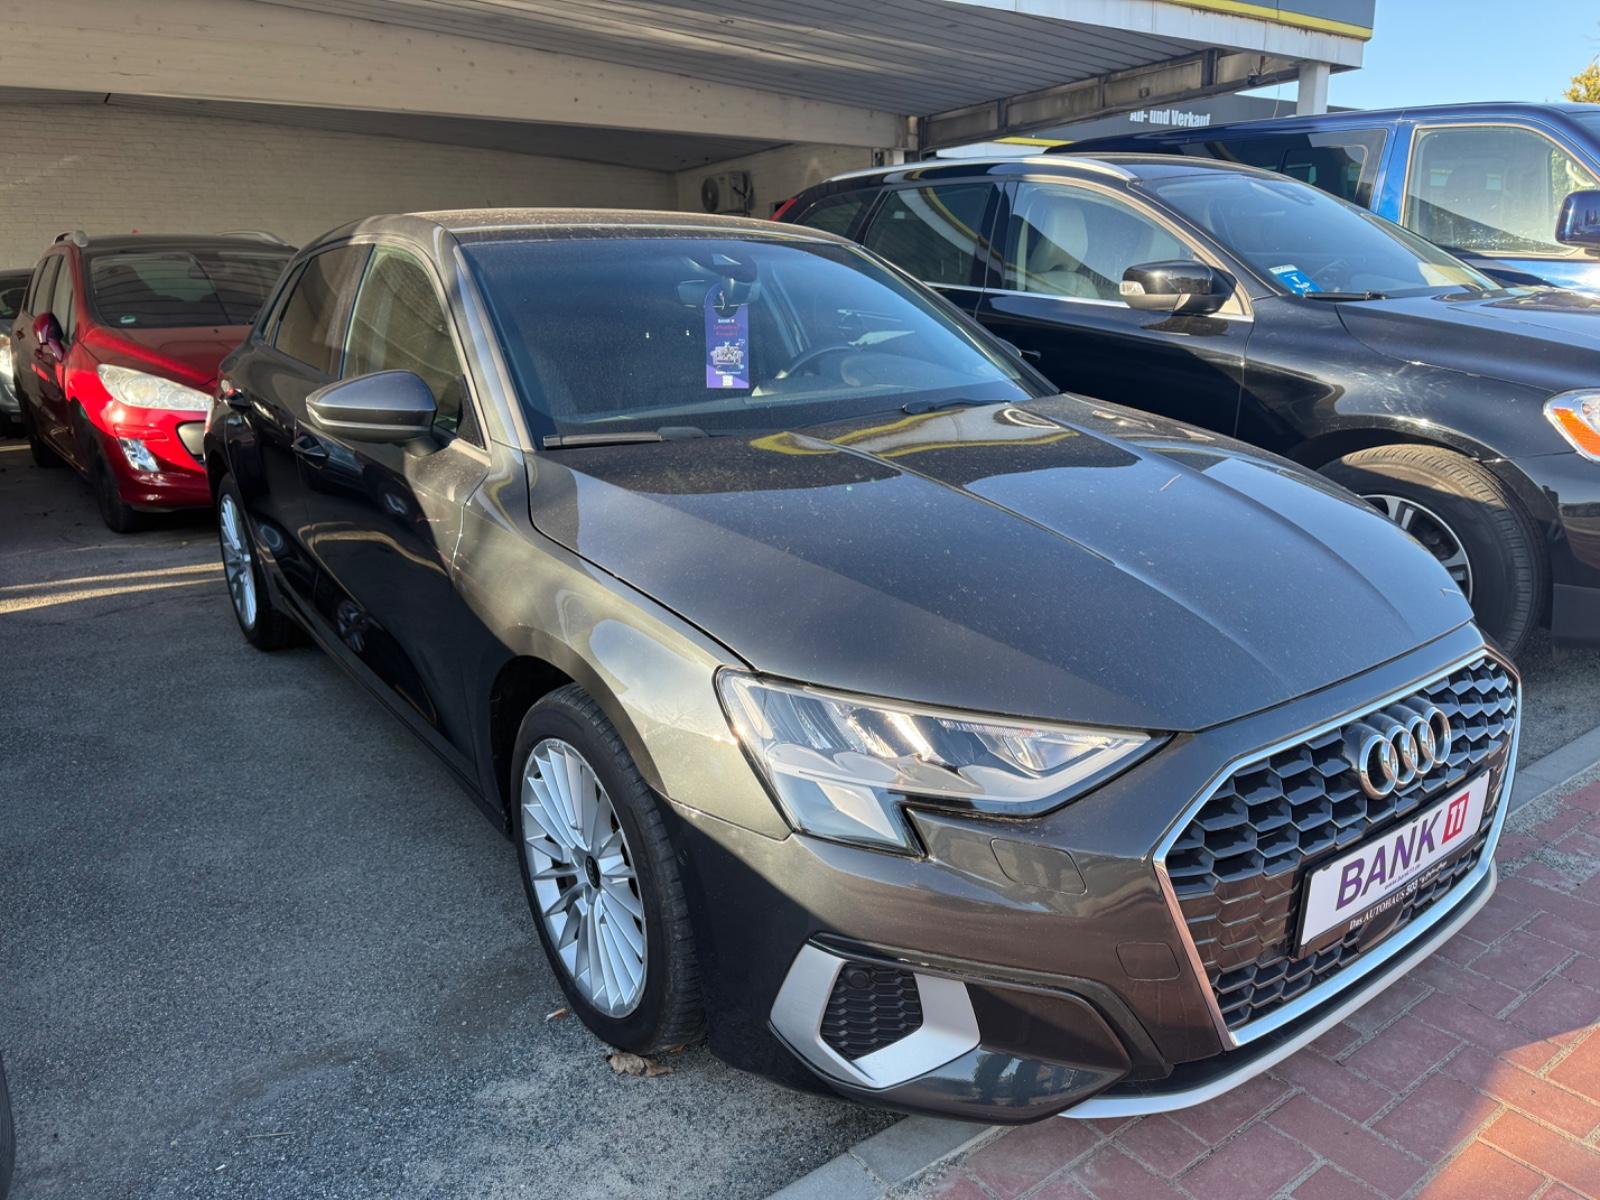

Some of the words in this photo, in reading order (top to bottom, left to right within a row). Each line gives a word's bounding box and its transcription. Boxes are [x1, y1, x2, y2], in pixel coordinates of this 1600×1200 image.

[1149, 109, 1170, 125] und
[1171, 109, 1211, 127] Verkauf
[1335, 809, 1443, 912] BANK
[1364, 888, 1406, 920] AUTOHAUS
